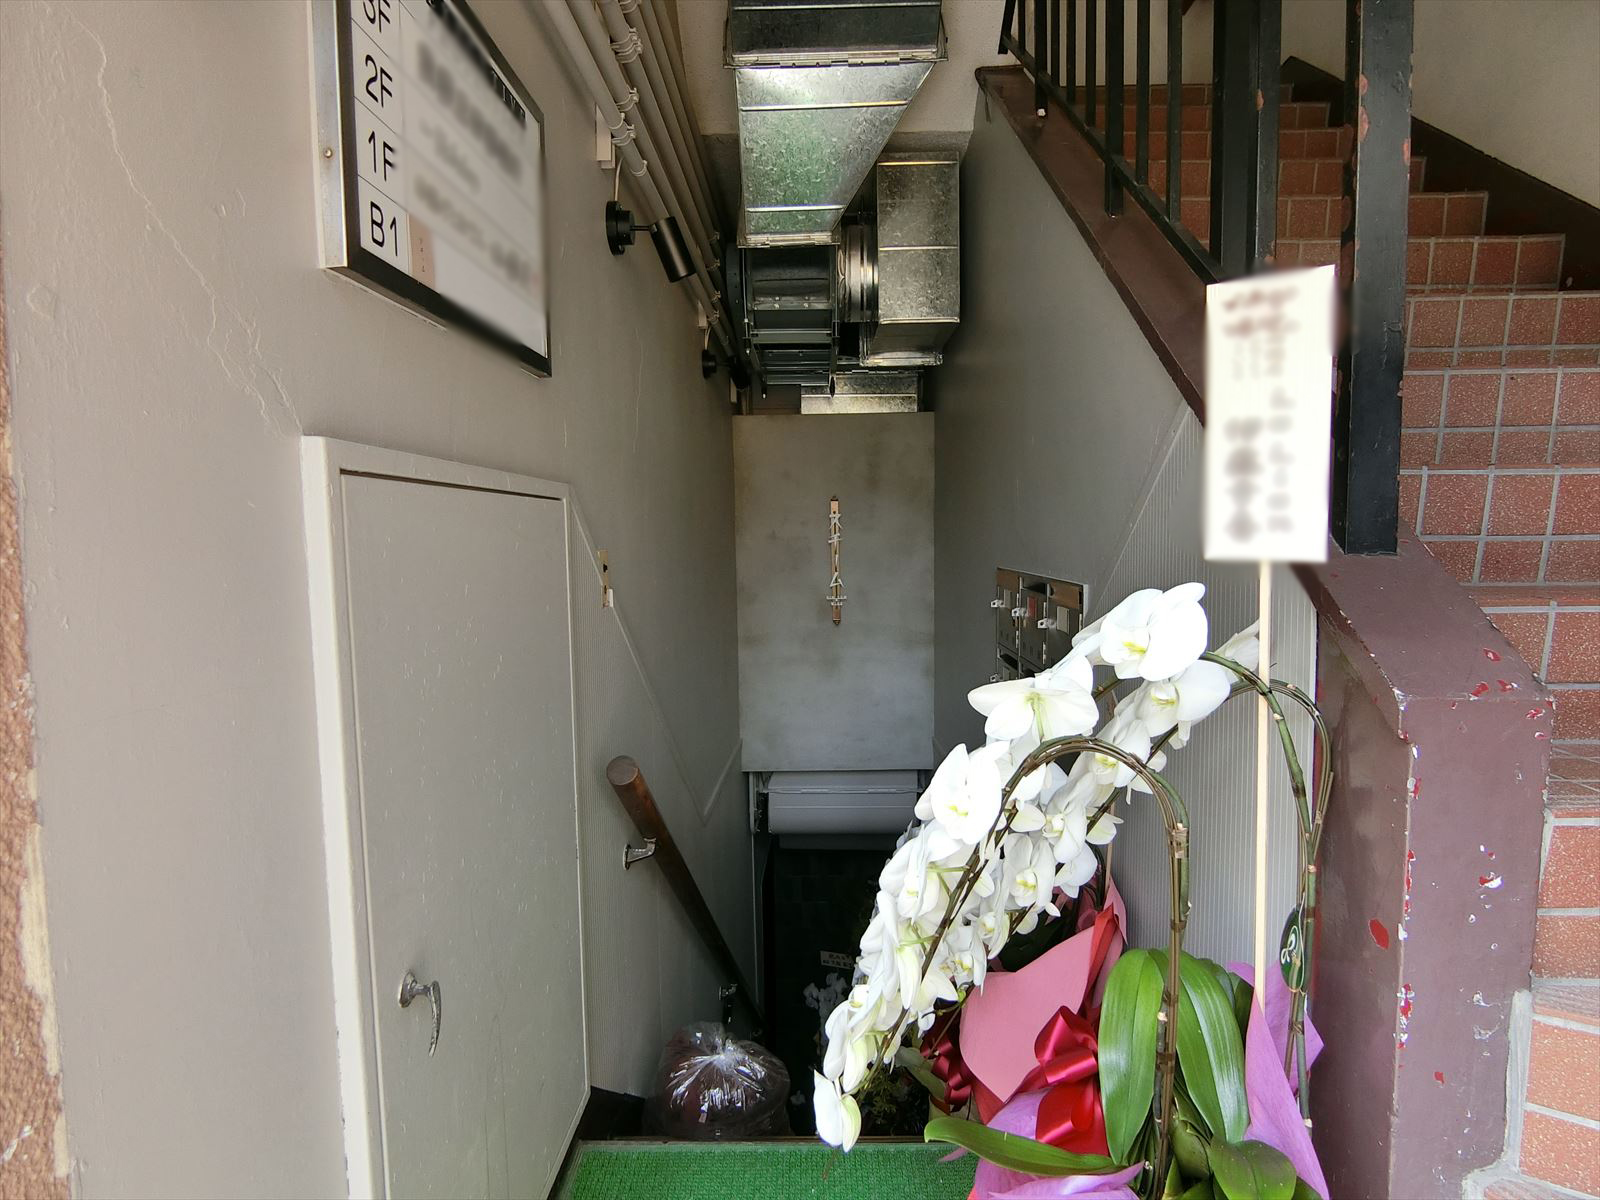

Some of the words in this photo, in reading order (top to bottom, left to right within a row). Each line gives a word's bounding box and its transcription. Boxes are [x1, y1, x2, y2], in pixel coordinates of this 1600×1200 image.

[364, 54, 393, 108] 2F
[367, 130, 395, 182] 1F
[369, 200, 399, 257] B1
